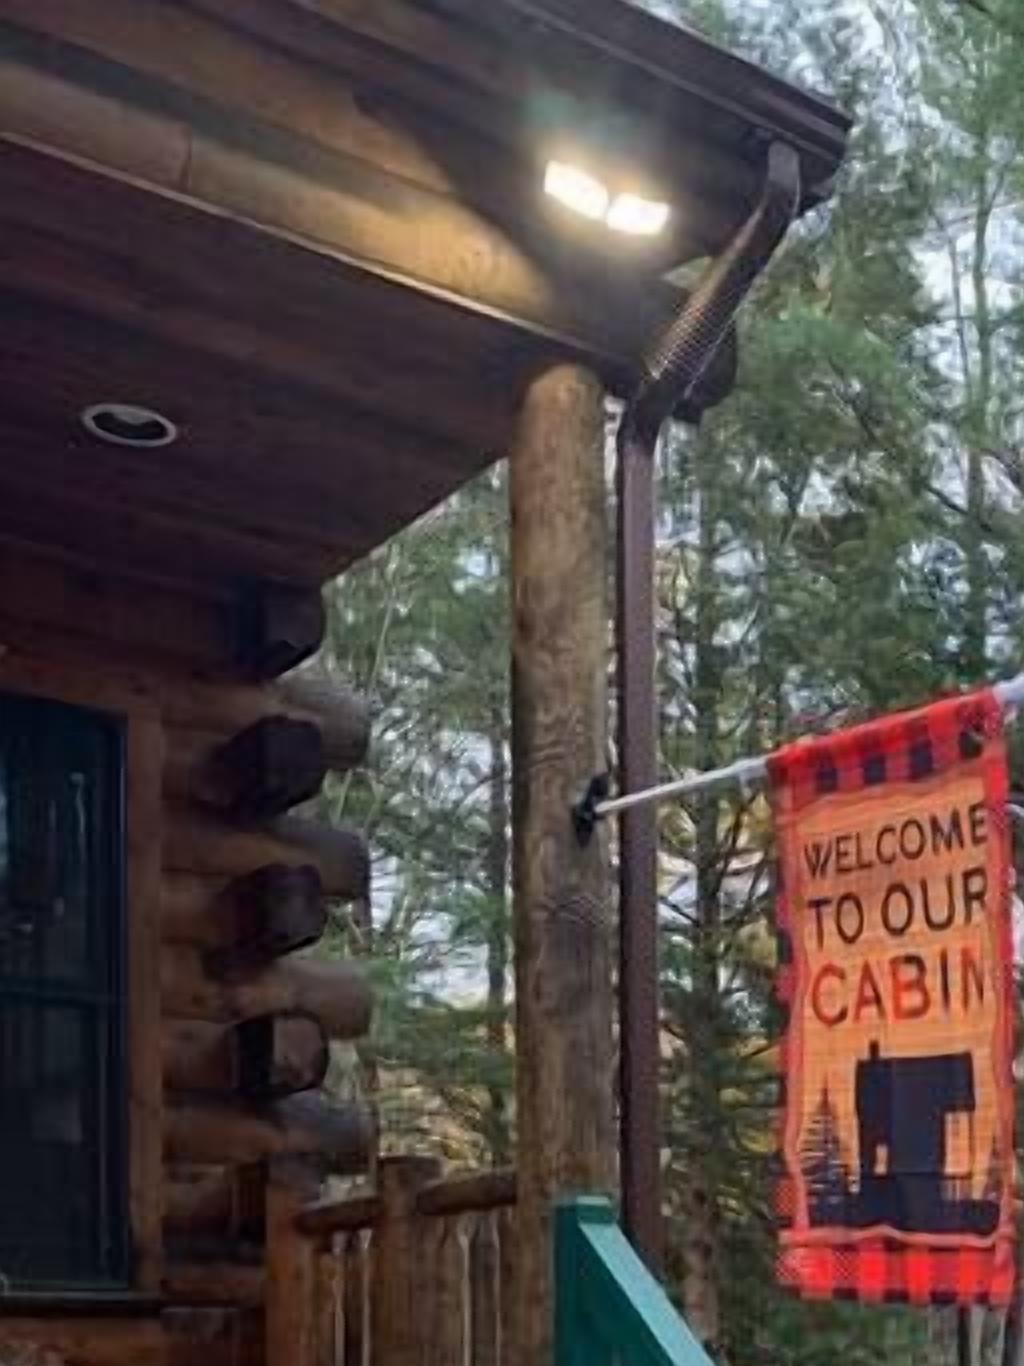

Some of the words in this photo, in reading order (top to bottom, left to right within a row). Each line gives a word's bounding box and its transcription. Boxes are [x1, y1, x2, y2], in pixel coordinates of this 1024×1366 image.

[804, 802, 987, 879] WELCOME
[807, 892, 865, 949] TO
[881, 867, 988, 936] OUR
[811, 947, 985, 1027] CABIN
